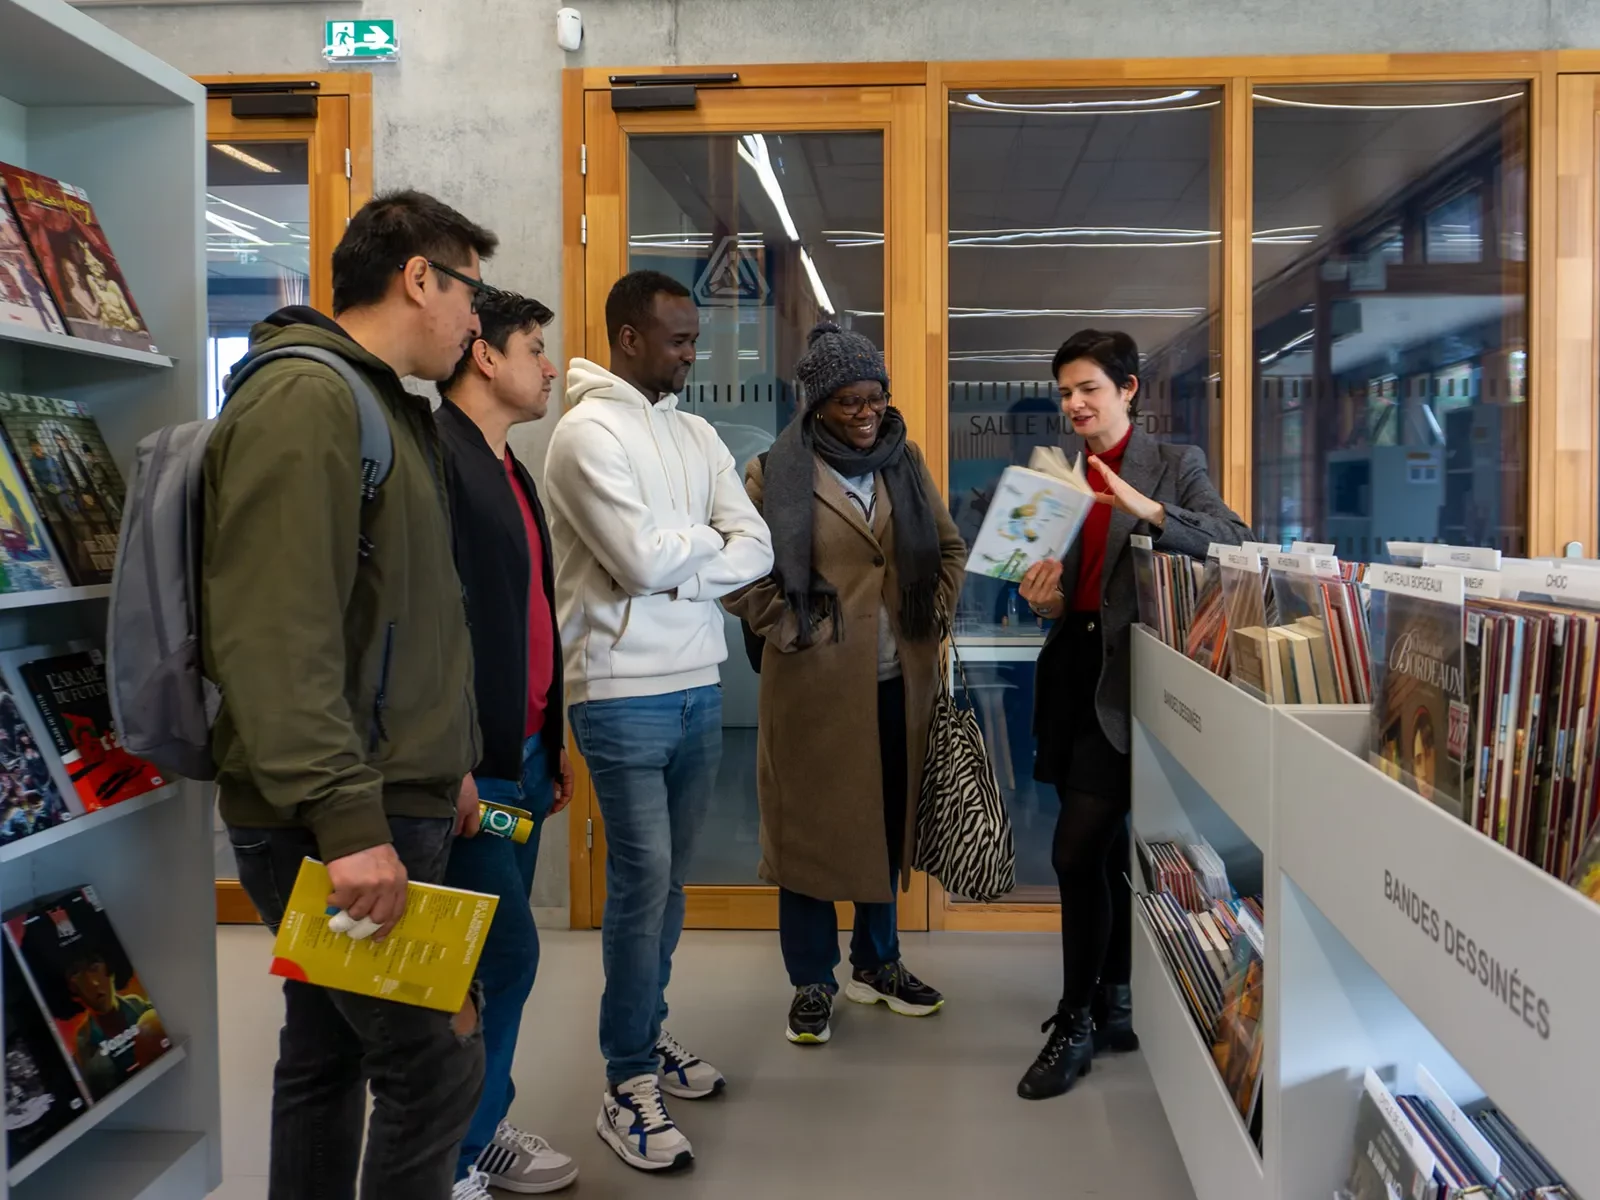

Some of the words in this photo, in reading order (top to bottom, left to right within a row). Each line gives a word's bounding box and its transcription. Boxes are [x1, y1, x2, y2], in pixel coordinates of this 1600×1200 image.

[970, 415, 1038, 436] SALLE
[1411, 573, 1443, 593] BORDEAUX
[1545, 573, 1568, 590] CHOC
[1384, 869, 1440, 943] BANDES
[1444, 919, 1550, 1041] DESSINÉES
